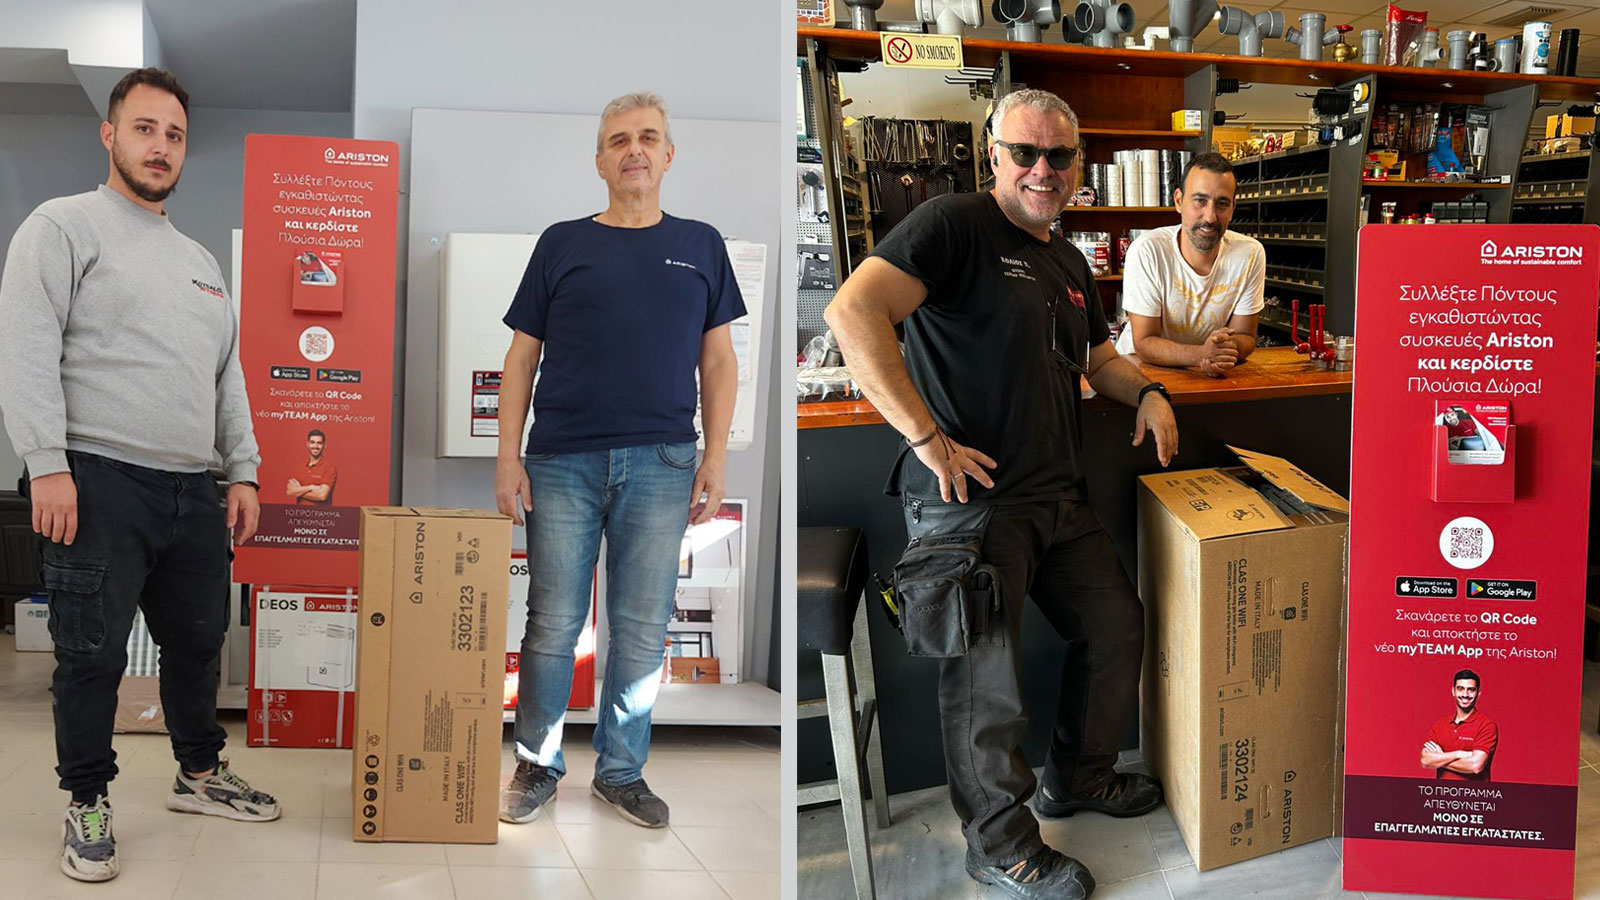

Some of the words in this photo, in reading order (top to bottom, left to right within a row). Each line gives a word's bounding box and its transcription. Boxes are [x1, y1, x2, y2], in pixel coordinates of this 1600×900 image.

[915, 44, 925, 60] NO
[926, 45, 956, 61] SMOKING
[337, 152, 389, 162] ARISTON
[272, 173, 322, 187] Συλλέξτε
[325, 176, 373, 190] Πόντους
[279, 190, 363, 204] εγκαθιστώντας
[272, 204, 326, 217] συσκευές
[328, 206, 371, 218] Ariston
[285, 220, 304, 230] και
[306, 221, 358, 232] κερδίστε
[278, 232, 326, 245] Πλούσια
[328, 236, 364, 248] Δώρα!
[1501, 246, 1582, 258] ARISTON
[1400, 285, 1477, 304] Συλλέξτε
[1481, 286, 1557, 304] Πόντους
[1409, 308, 1542, 328] εγκαθιστώντας
[1400, 334, 1483, 350] συσκευές
[1486, 332, 1554, 348] Ariston
[1418, 357, 1446, 370] και
[1450, 354, 1534, 374] κερδίστε
[270, 388, 312, 399] Σκανάρετε
[326, 390, 338, 400] QR
[340, 391, 362, 400] Code
[1408, 377, 1482, 394] Πλούσια
[1485, 378, 1542, 397] Δώρα!
[294, 401, 339, 411] αποκτήστε
[256, 410, 270, 418] νέο
[270, 410, 309, 420] myTEAM
[310, 412, 328, 422] App
[414, 522, 426, 585] ARISTON
[509, 564, 528, 576] OS
[1238, 558, 1247, 584] CLAS
[1238, 586, 1247, 606] ONE
[1413, 585, 1430, 594] App
[1432, 586, 1453, 594] Store
[1487, 587, 1515, 598] Google
[1516, 588, 1532, 598] Play
[260, 599, 298, 610] DEOS
[458, 586, 474, 652] 3302123
[1238, 607, 1246, 628] WIFI
[1396, 609, 1461, 622] Σκανάρετε
[1464, 614, 1478, 622] το
[1480, 612, 1500, 623] QR
[1502, 612, 1537, 625] Code
[1411, 629, 1430, 638] και
[1432, 628, 1501, 642] αποκτήστε
[1375, 642, 1395, 652] νέο
[1398, 643, 1454, 656] myTEAM
[1457, 645, 1483, 658] App
[1486, 648, 1506, 659] της
[1509, 647, 1557, 659] Ariston!
[457, 760, 465, 780] WIFI
[1235, 739, 1249, 802] 3302124
[456, 781, 464, 800] ONE
[1418, 786, 1433, 795] ΤΟ
[1435, 786, 1503, 799] ΠΡΟΓΡΑΜΜΑ
[455, 802, 464, 824] CLAS
[1424, 799, 1496, 811] ΑΠΕΥΘΥΝΕΤΑΙ
[1282, 789, 1292, 844] ARISTON
[1433, 813, 1468, 823] ΜΟΝΟ
[1470, 814, 1484, 824] ΣΕ
[1374, 822, 1460, 836] ΕΠΑΓΓΕΛΜΑΤΙΕΣ
[1462, 828, 1545, 841] ΕΓΚΑΤΑΣΤΑΤΕΣ.
